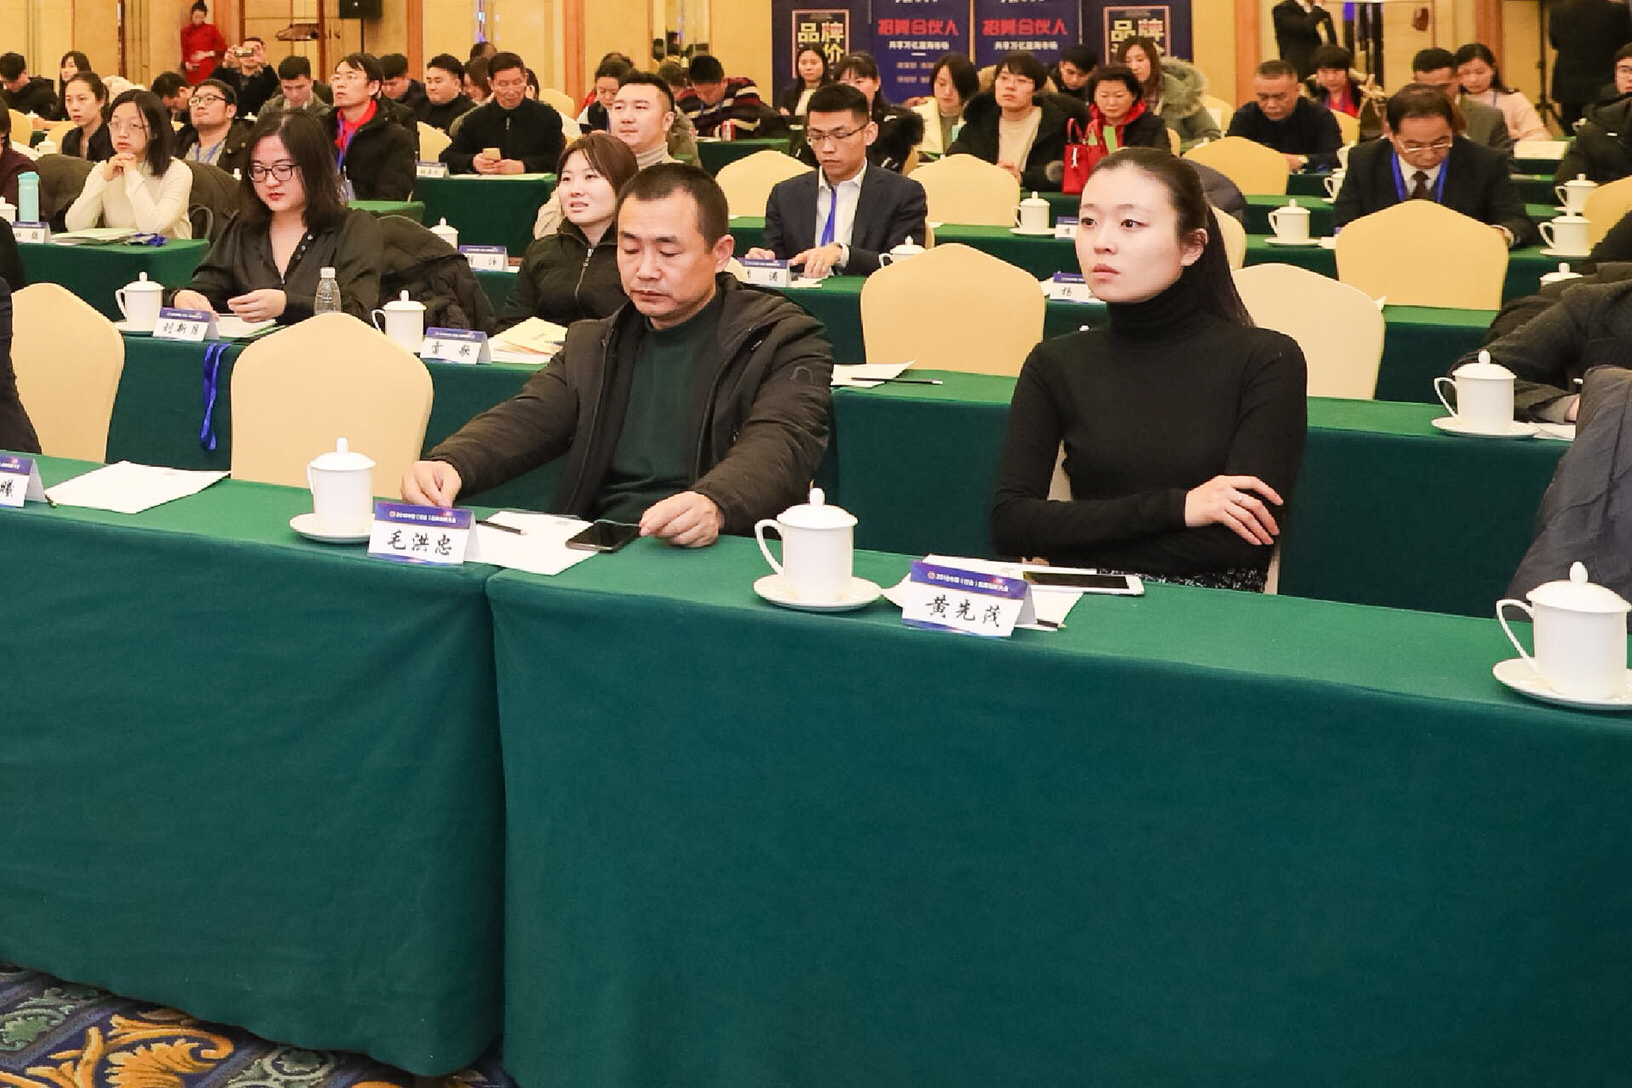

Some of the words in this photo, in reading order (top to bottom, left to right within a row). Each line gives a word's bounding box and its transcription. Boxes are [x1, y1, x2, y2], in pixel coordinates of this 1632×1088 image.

[387, 529, 453, 556] 毛洪忠
[925, 594, 1003, 628] 黄先茂
